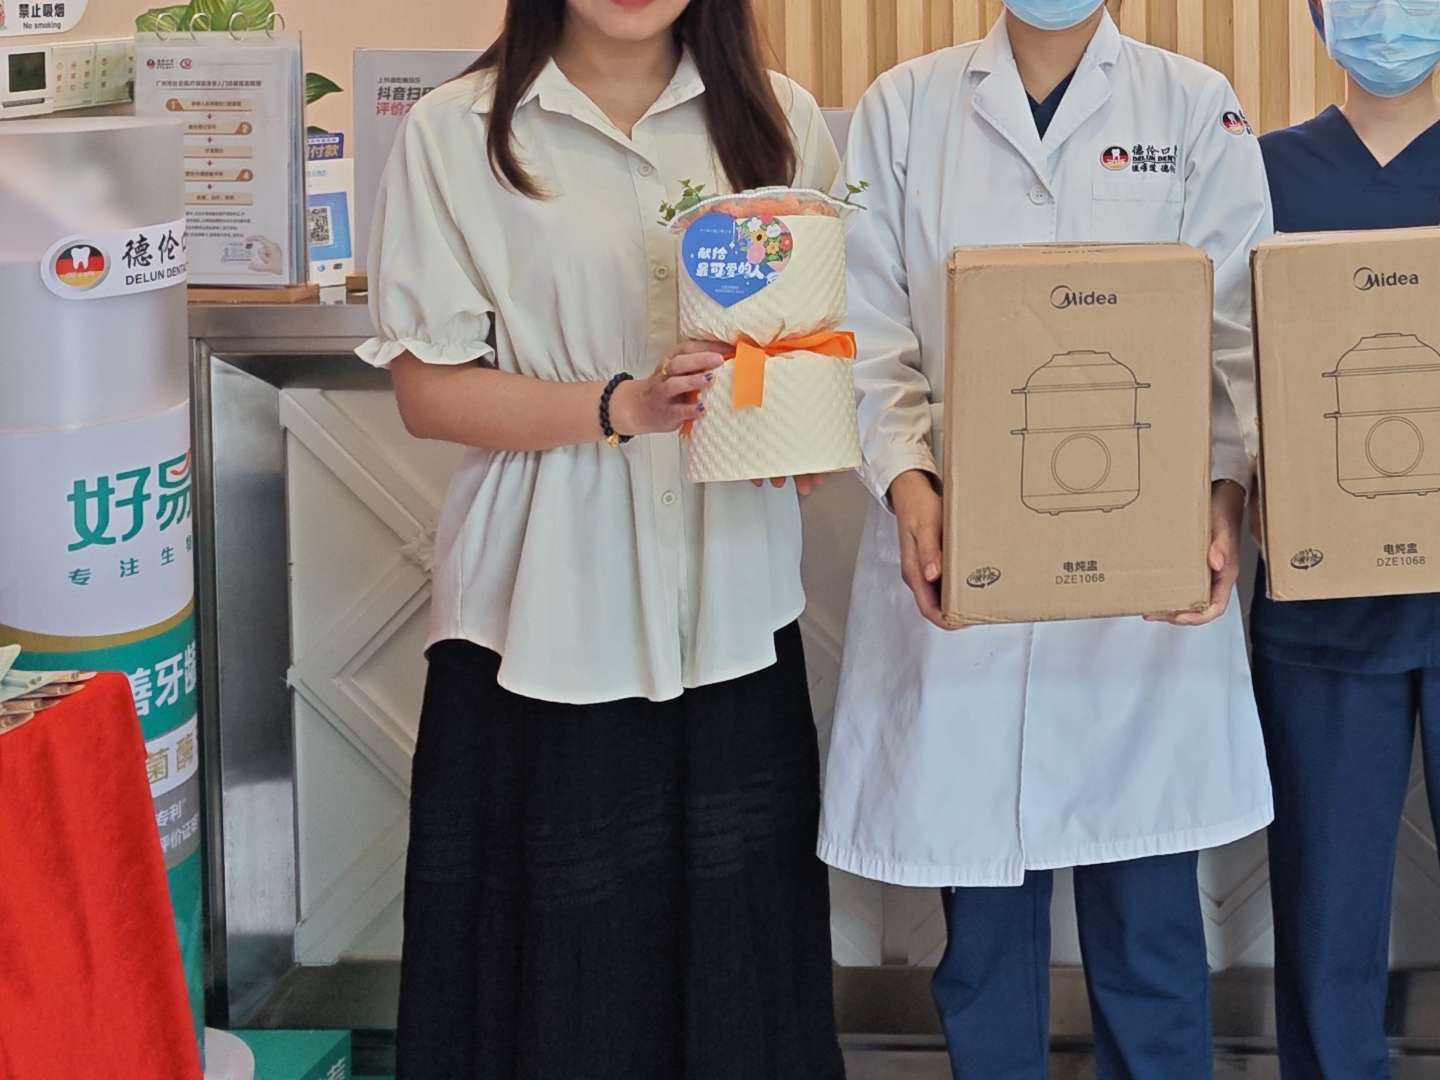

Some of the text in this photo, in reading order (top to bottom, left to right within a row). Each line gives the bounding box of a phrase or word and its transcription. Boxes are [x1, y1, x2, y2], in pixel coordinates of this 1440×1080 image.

[18, 3, 65, 19] 禁止吸烟
[23, 21, 62, 30] No smoking
[308, 144, 340, 159] 付款
[698, 247, 728, 261] 献给
[696, 261, 764, 280] 最可爱的人
[125, 270, 165, 286] DELUN
[1359, 269, 1418, 289] Midea
[1057, 288, 1118, 308] Midea
[1383, 543, 1418, 555] 电炖盅
[1063, 560, 1098, 572] 电炖盅
[1376, 556, 1426, 567] DZE1068
[1055, 573, 1105, 585] DZE1068
